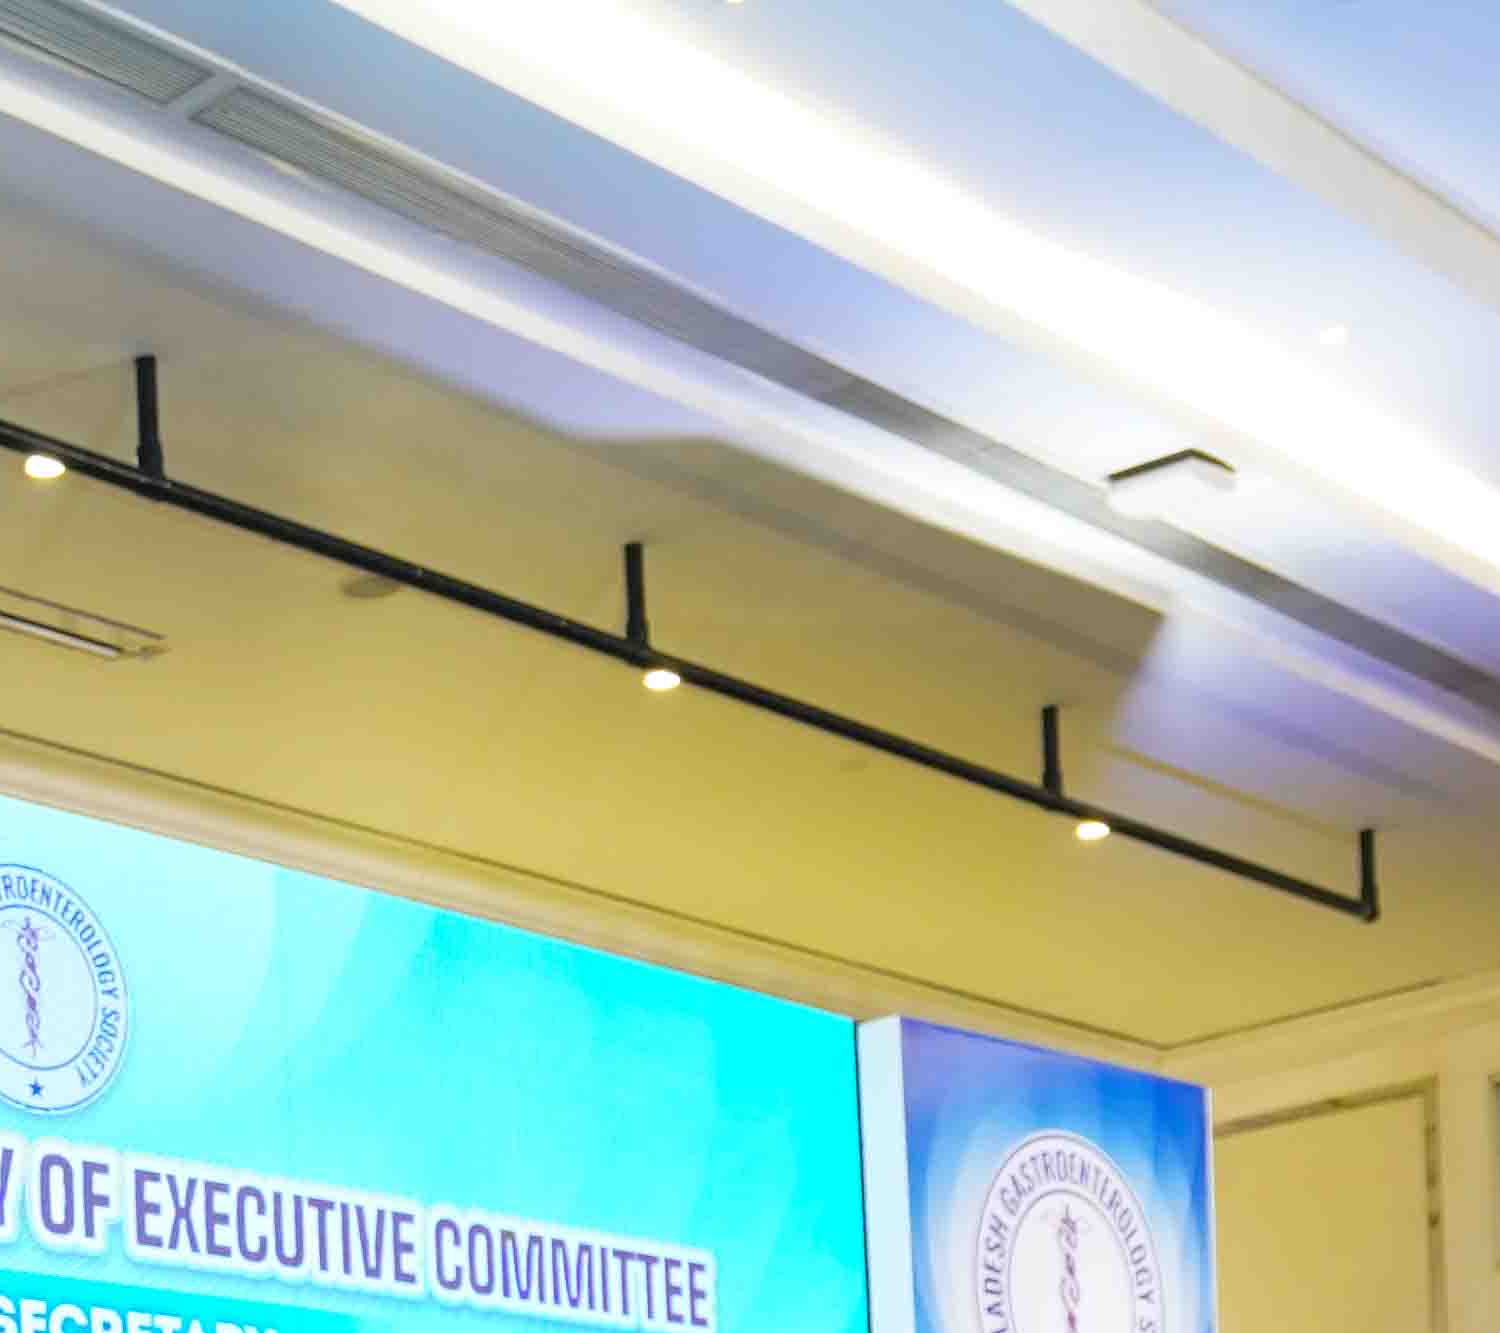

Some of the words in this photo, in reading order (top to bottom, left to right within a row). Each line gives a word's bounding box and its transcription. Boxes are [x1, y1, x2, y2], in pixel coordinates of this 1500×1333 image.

[76, 1006, 121, 1088] SOCIETY
[38, 1151, 110, 1242] OF
[135, 1168, 417, 1285] EXECUTIVE
[434, 1218, 709, 1328] COMMITTEE
[1000, 1149, 1155, 1306] GASTROENTEROLOGY
